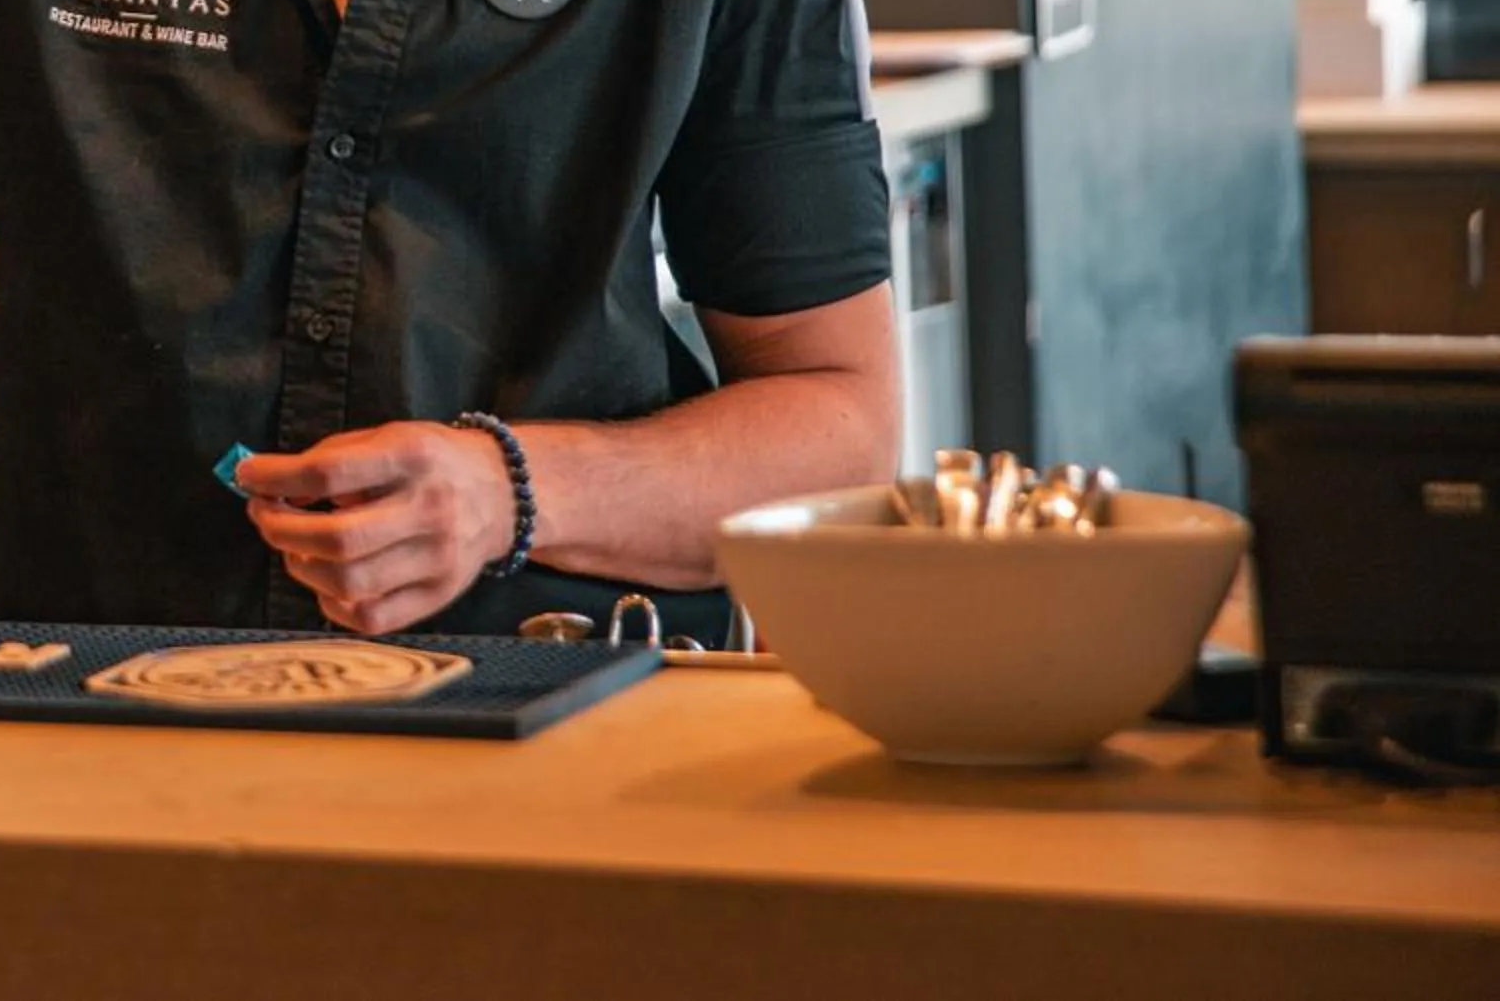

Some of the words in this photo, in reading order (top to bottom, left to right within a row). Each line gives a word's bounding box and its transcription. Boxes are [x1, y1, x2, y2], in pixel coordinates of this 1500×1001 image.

[49, 7, 140, 39] RESTAURANT
[141, 23, 155, 42] &
[156, 24, 195, 46] WINE
[197, 30, 230, 52] BAR
